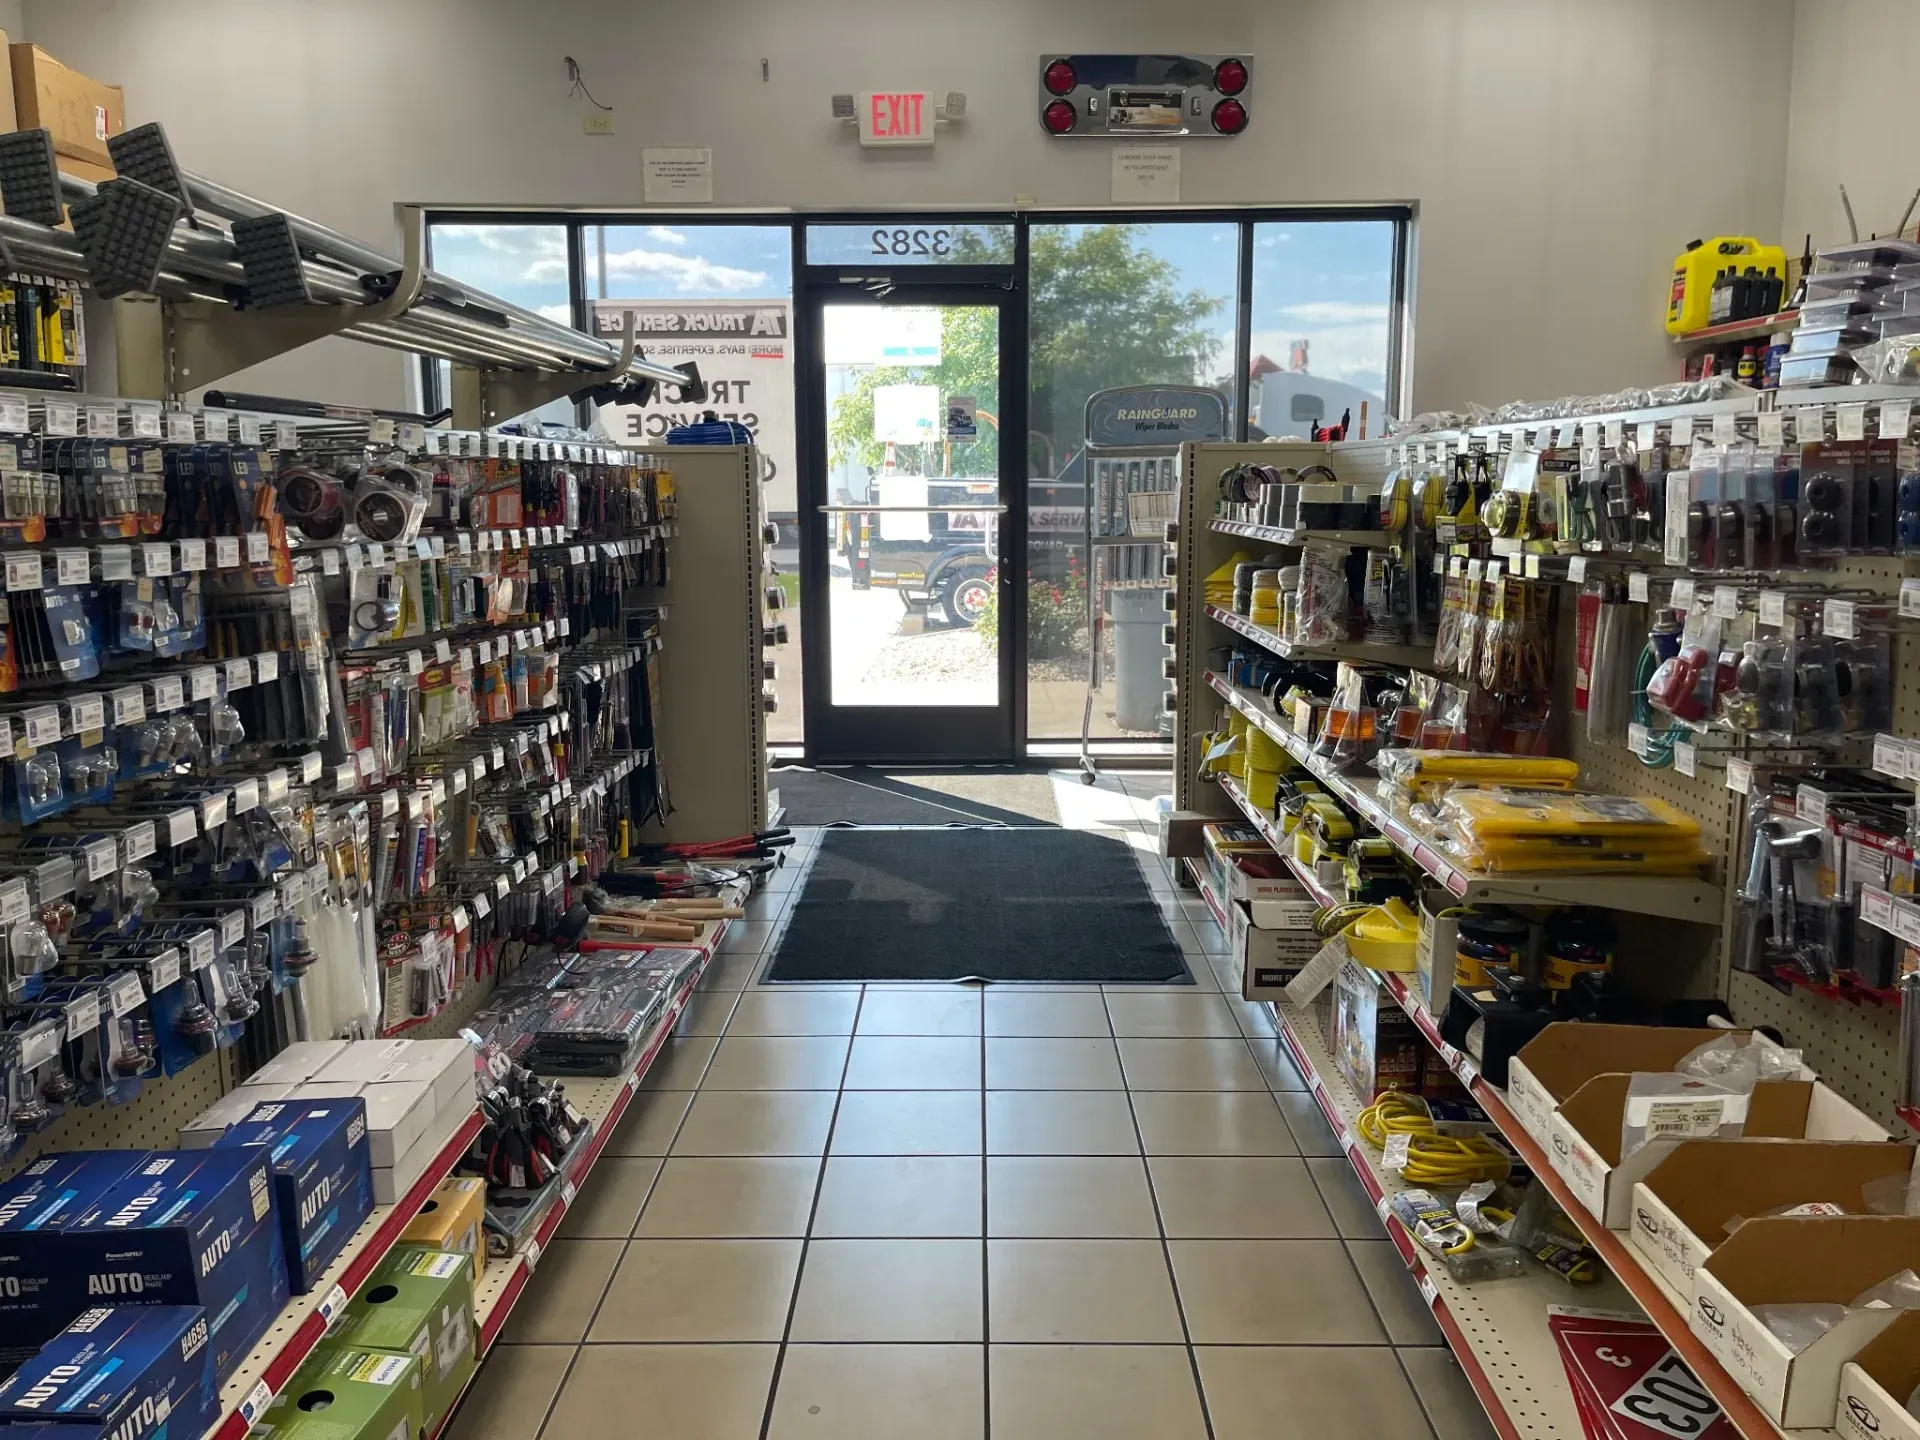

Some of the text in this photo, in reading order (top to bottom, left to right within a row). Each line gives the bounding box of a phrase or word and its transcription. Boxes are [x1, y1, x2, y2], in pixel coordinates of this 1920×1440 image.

[871, 94, 924, 136] EXIT
[1117, 408, 1197, 421] RAINGUARD
[1134, 422, 1179, 432] Wiper Blades
[233, 461, 249, 475] LED
[45, 595, 64, 609] AUTO
[1261, 973, 1283, 982] MORE
[103, 1196, 159, 1226] AUTO
[301, 1176, 331, 1230] AUTO
[200, 1229, 231, 1278] AUTO
[435, 1255, 455, 1276] PHILIPS
[88, 1272, 144, 1296] AUTO
[143, 1273, 172, 1281] HEADLAMP
[145, 1280, 163, 1288] PHARE
[66, 1308, 108, 1333] H4656
[181, 1317, 208, 1356] H4656
[1595, 1346, 1632, 1368] 3
[377, 1358, 401, 1382] PHILIPS
[14, 1365, 82, 1409] AUTO
[102, 1395, 155, 1440] AUTO
